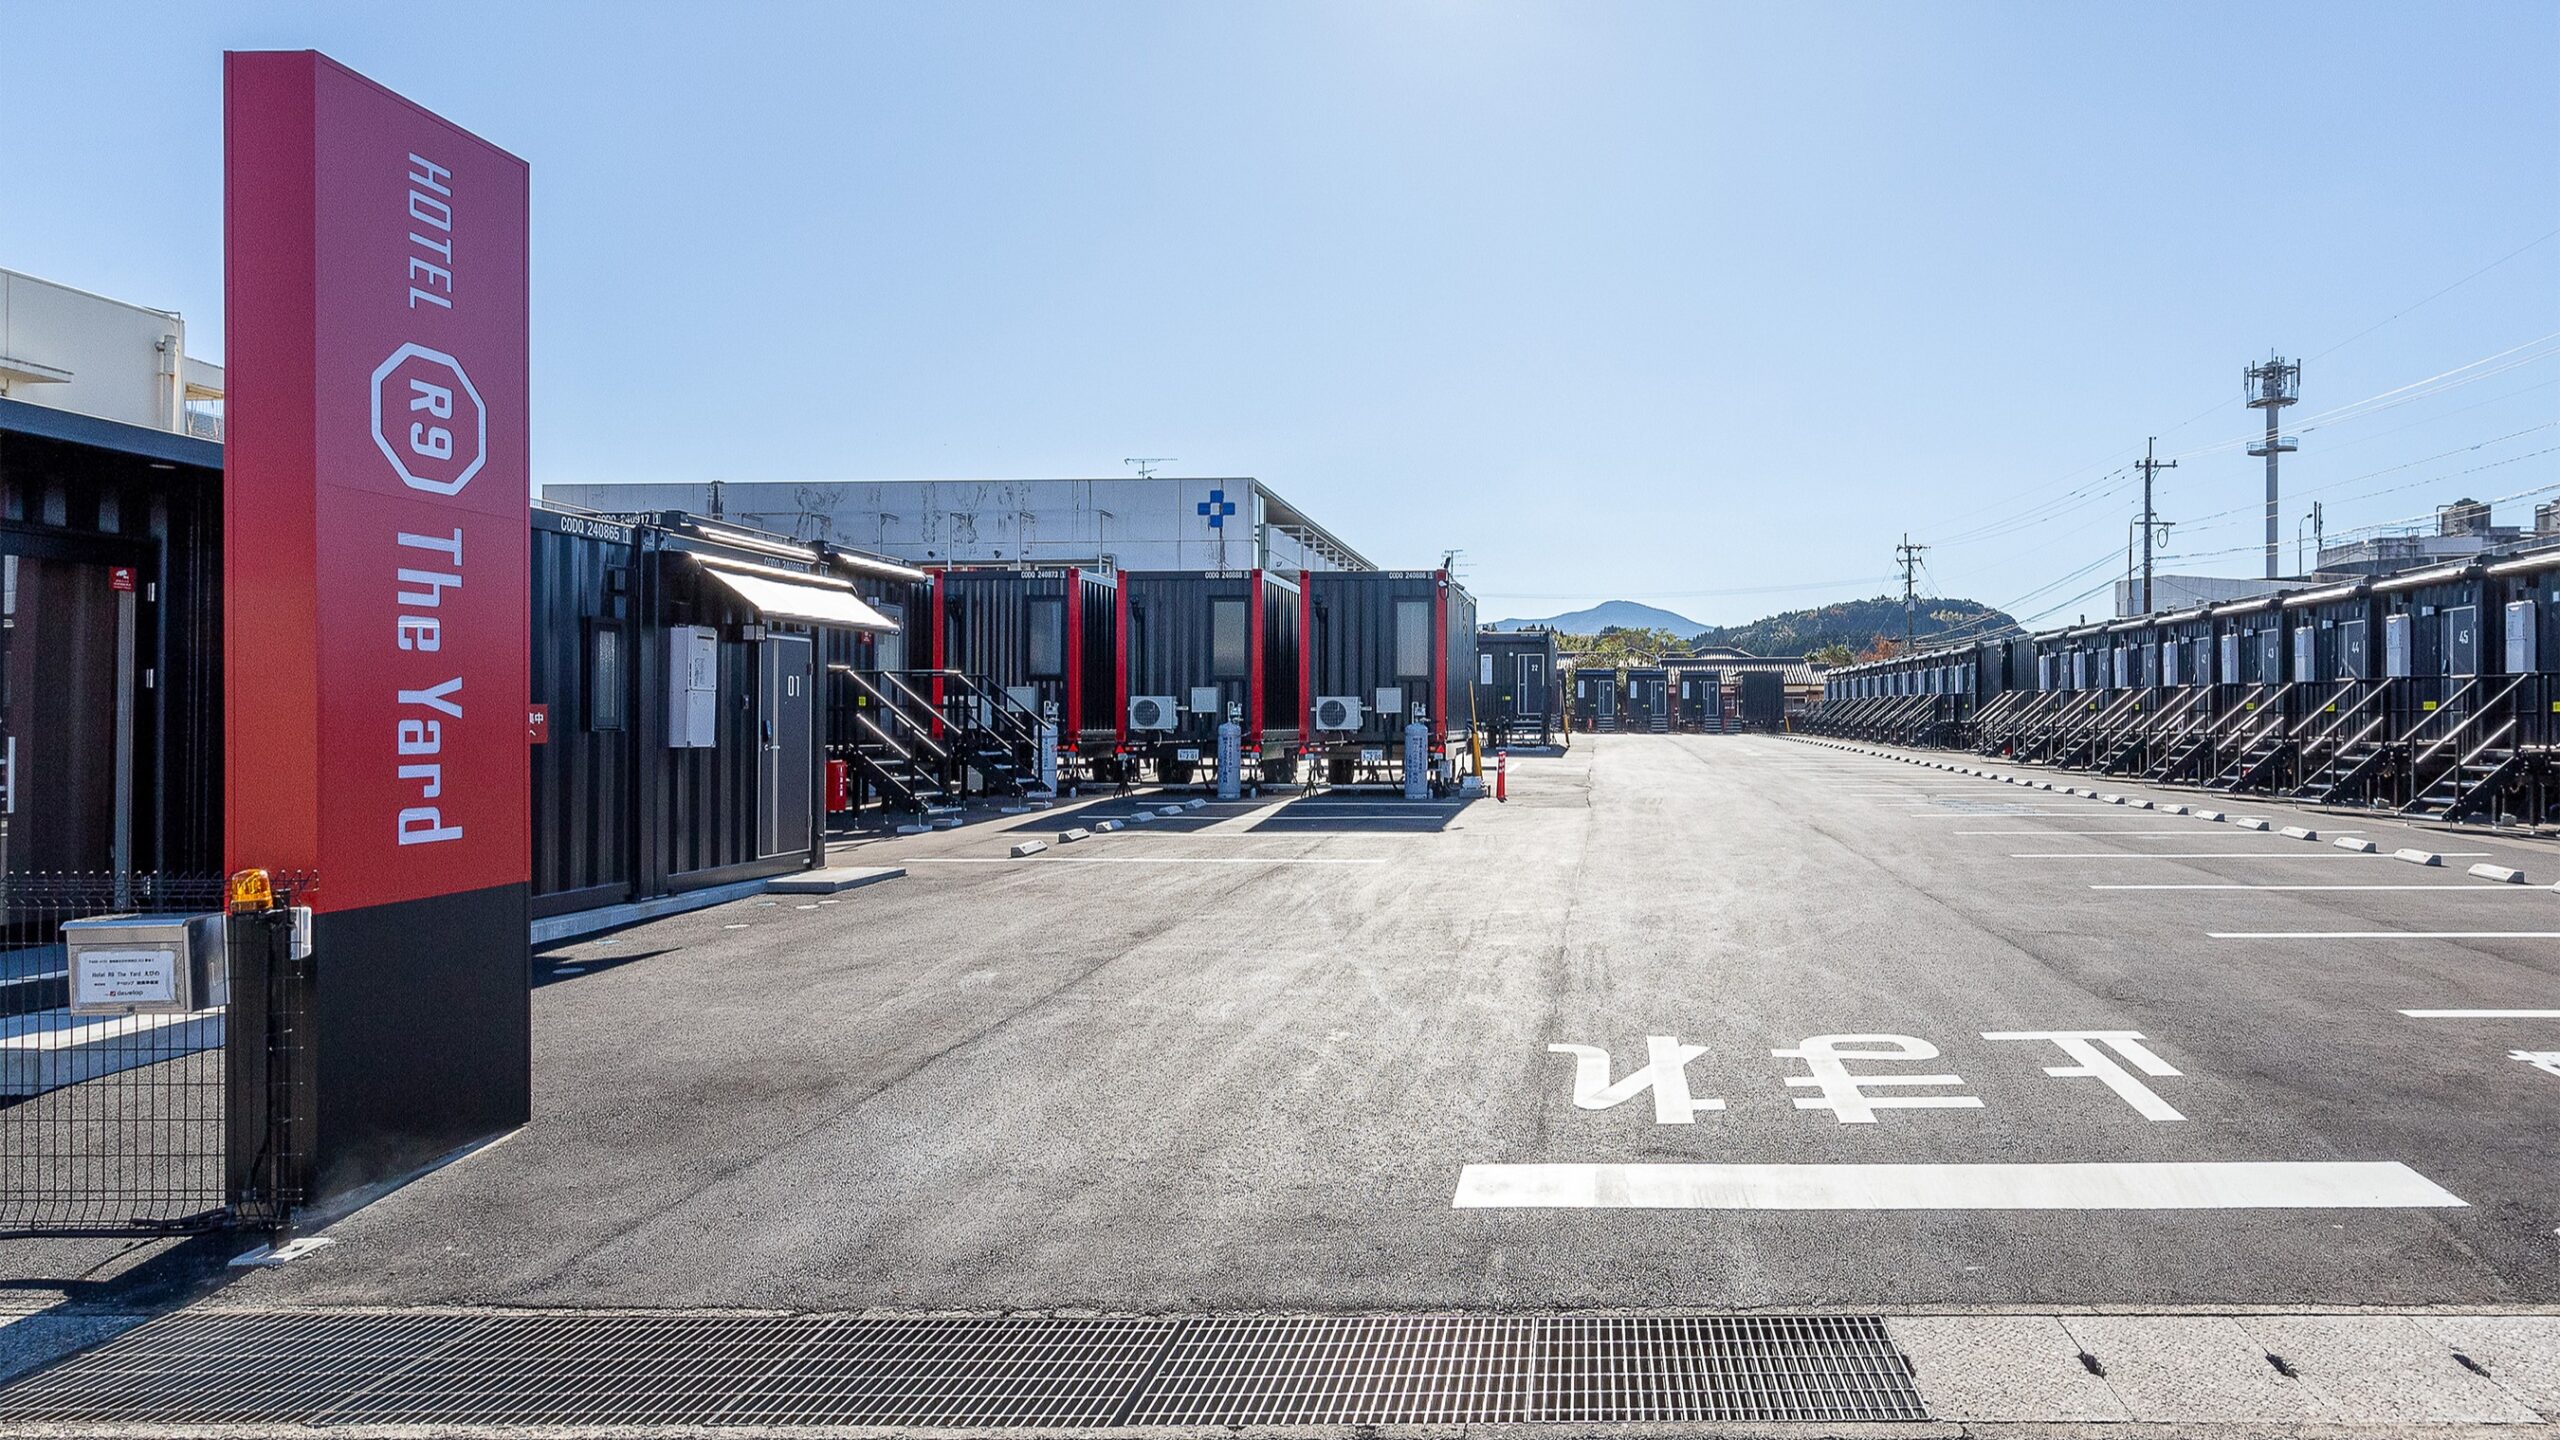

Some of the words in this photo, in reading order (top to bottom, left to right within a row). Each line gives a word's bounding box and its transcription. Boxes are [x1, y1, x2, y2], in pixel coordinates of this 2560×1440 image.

[408, 151, 452, 310] HOTEL
[410, 378, 453, 461] R9
[587, 521, 620, 541] 240865
[398, 528, 463, 652] The
[2351, 641, 2360, 654] 44
[2459, 629, 2469, 644] 45
[1531, 663, 1539, 672] 22
[787, 675, 801, 698] 01
[398, 676, 463, 846] Yard
